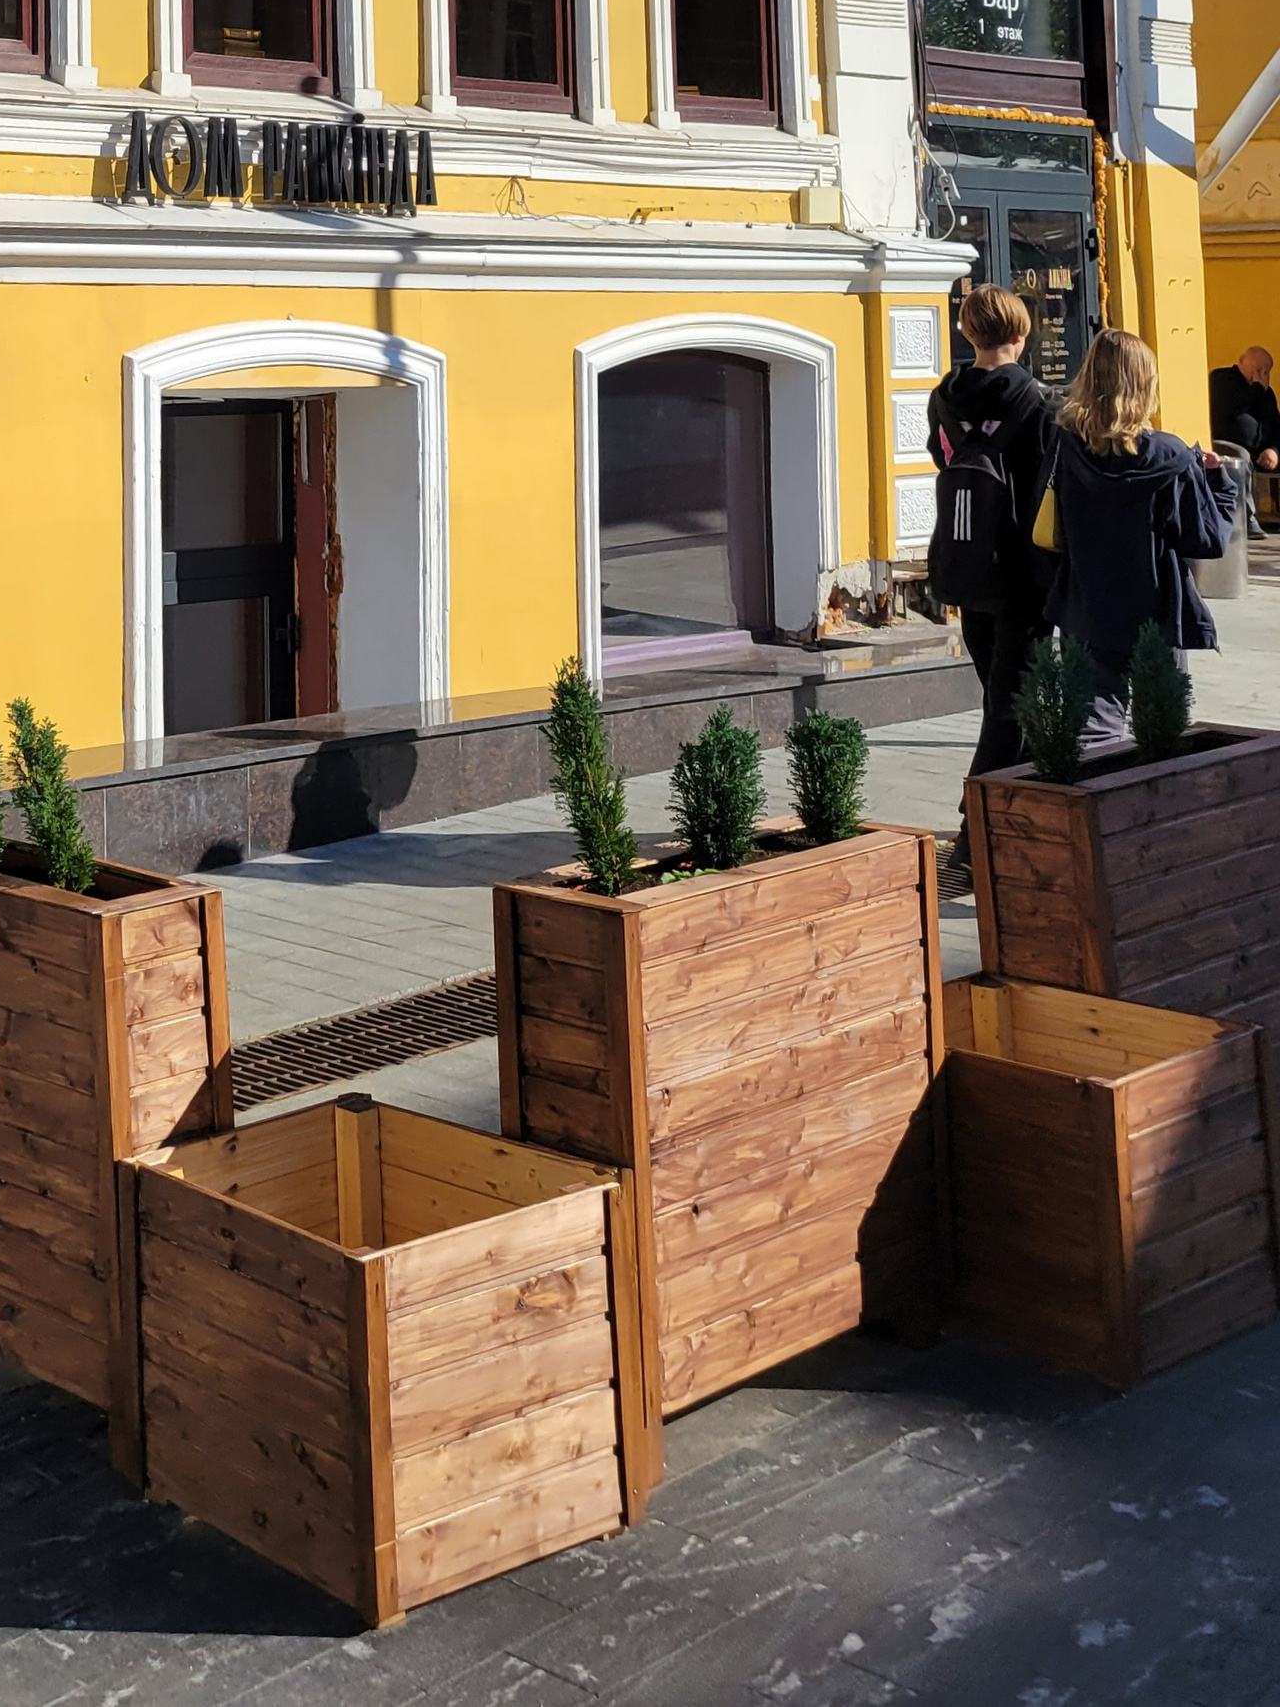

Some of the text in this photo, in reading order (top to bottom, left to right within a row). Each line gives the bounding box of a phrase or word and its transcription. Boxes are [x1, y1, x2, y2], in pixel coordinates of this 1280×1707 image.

[978, 18, 1023, 42] 1 этаж
[121, 111, 244, 206] ДОМ
